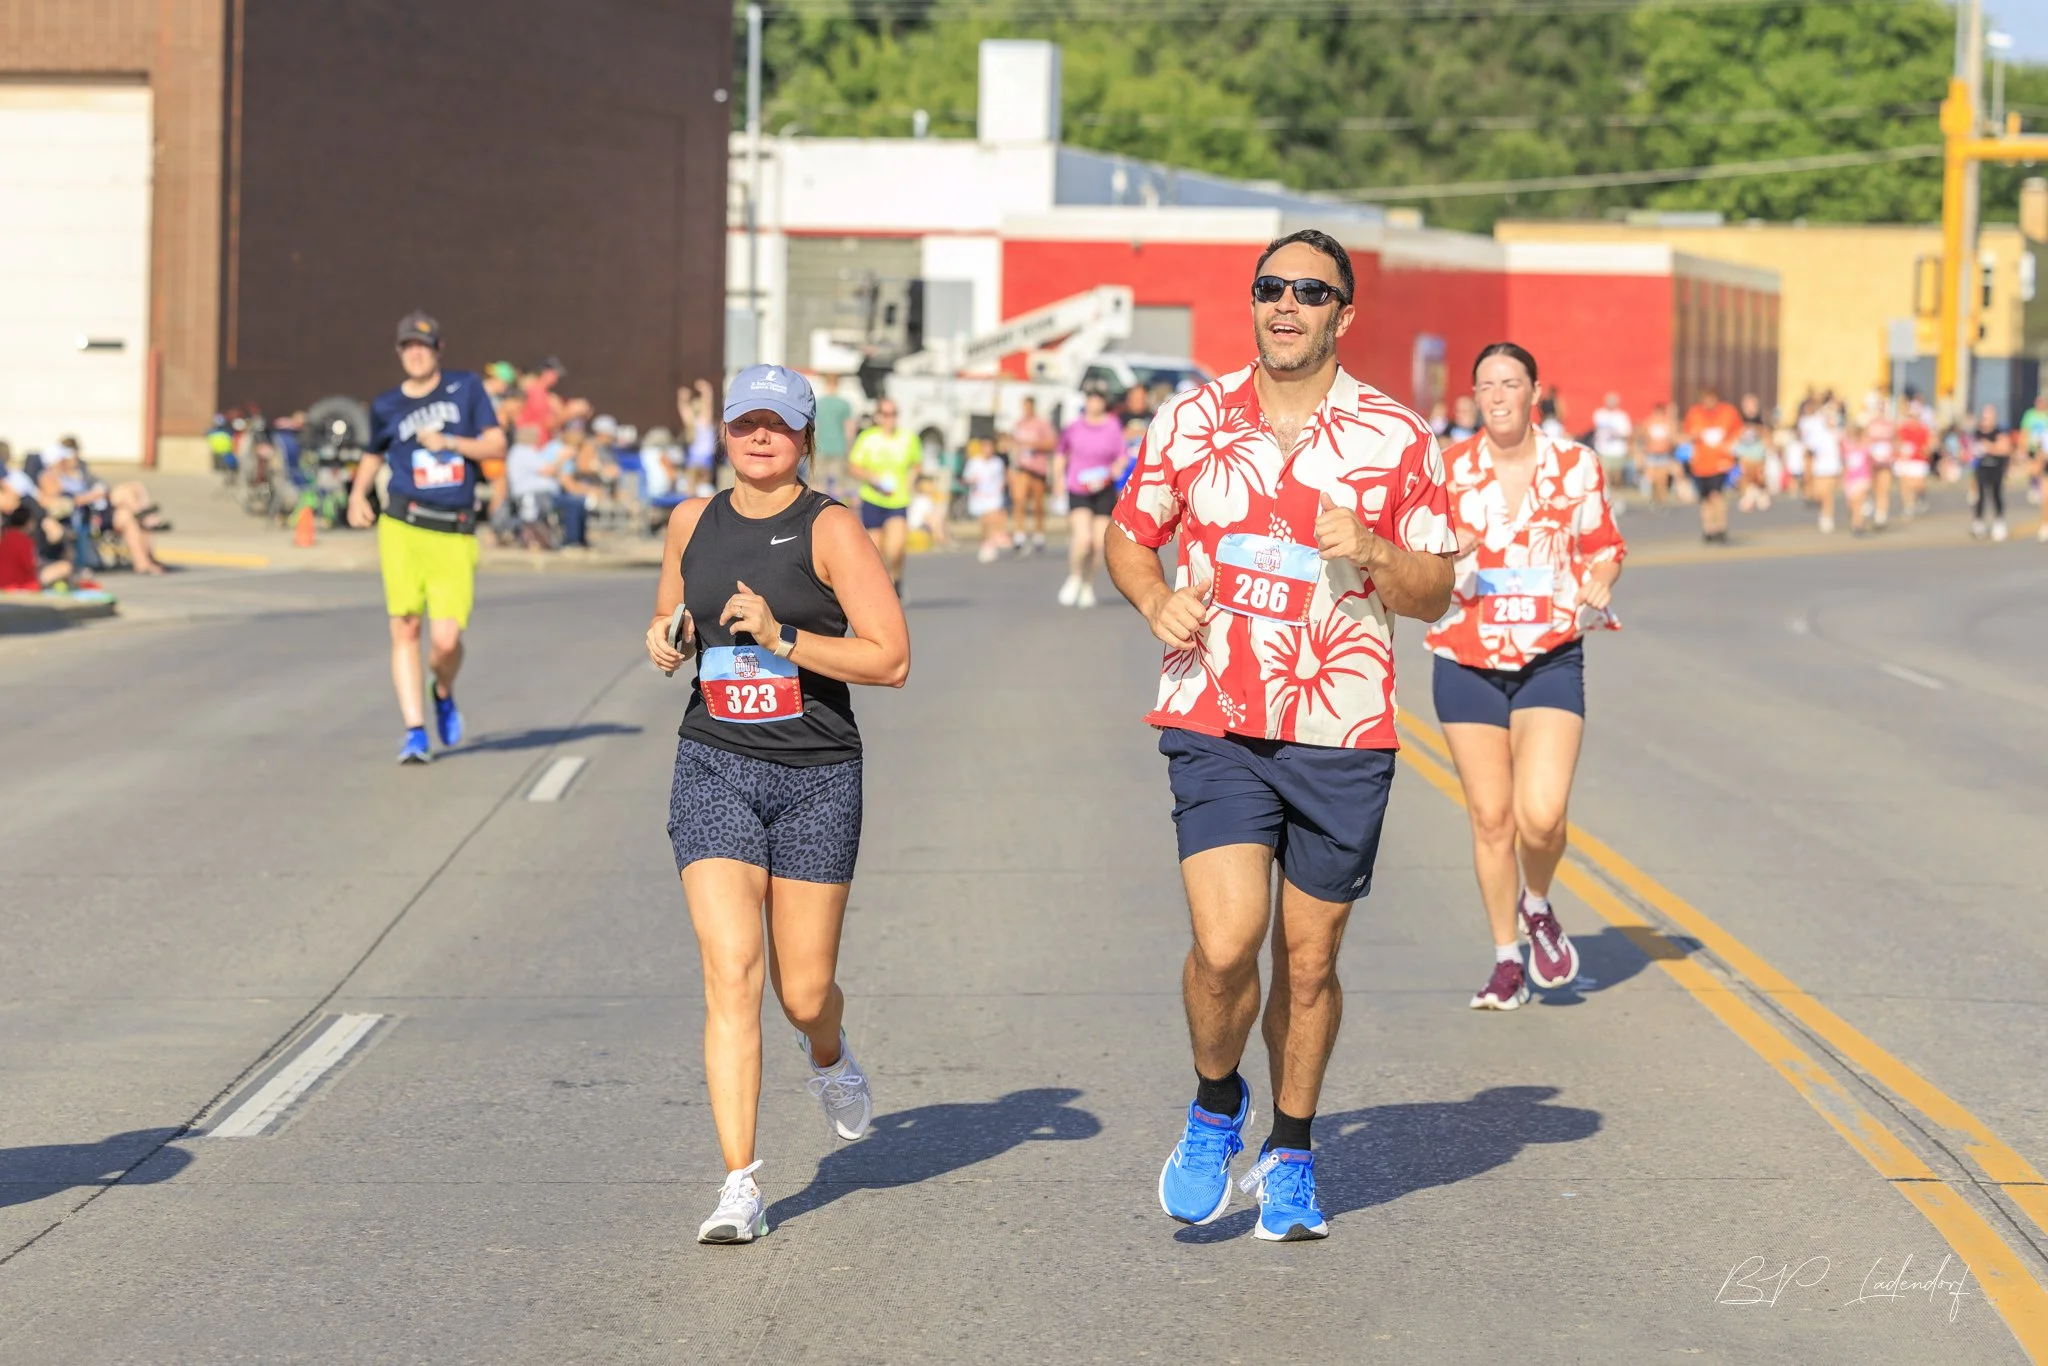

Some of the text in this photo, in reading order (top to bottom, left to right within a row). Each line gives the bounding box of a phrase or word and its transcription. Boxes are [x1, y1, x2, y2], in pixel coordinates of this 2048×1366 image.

[1233, 573, 1290, 613] 286
[1494, 597, 1536, 622] 285
[735, 661, 760, 674] ROUTE
[725, 684, 777, 714] 323
